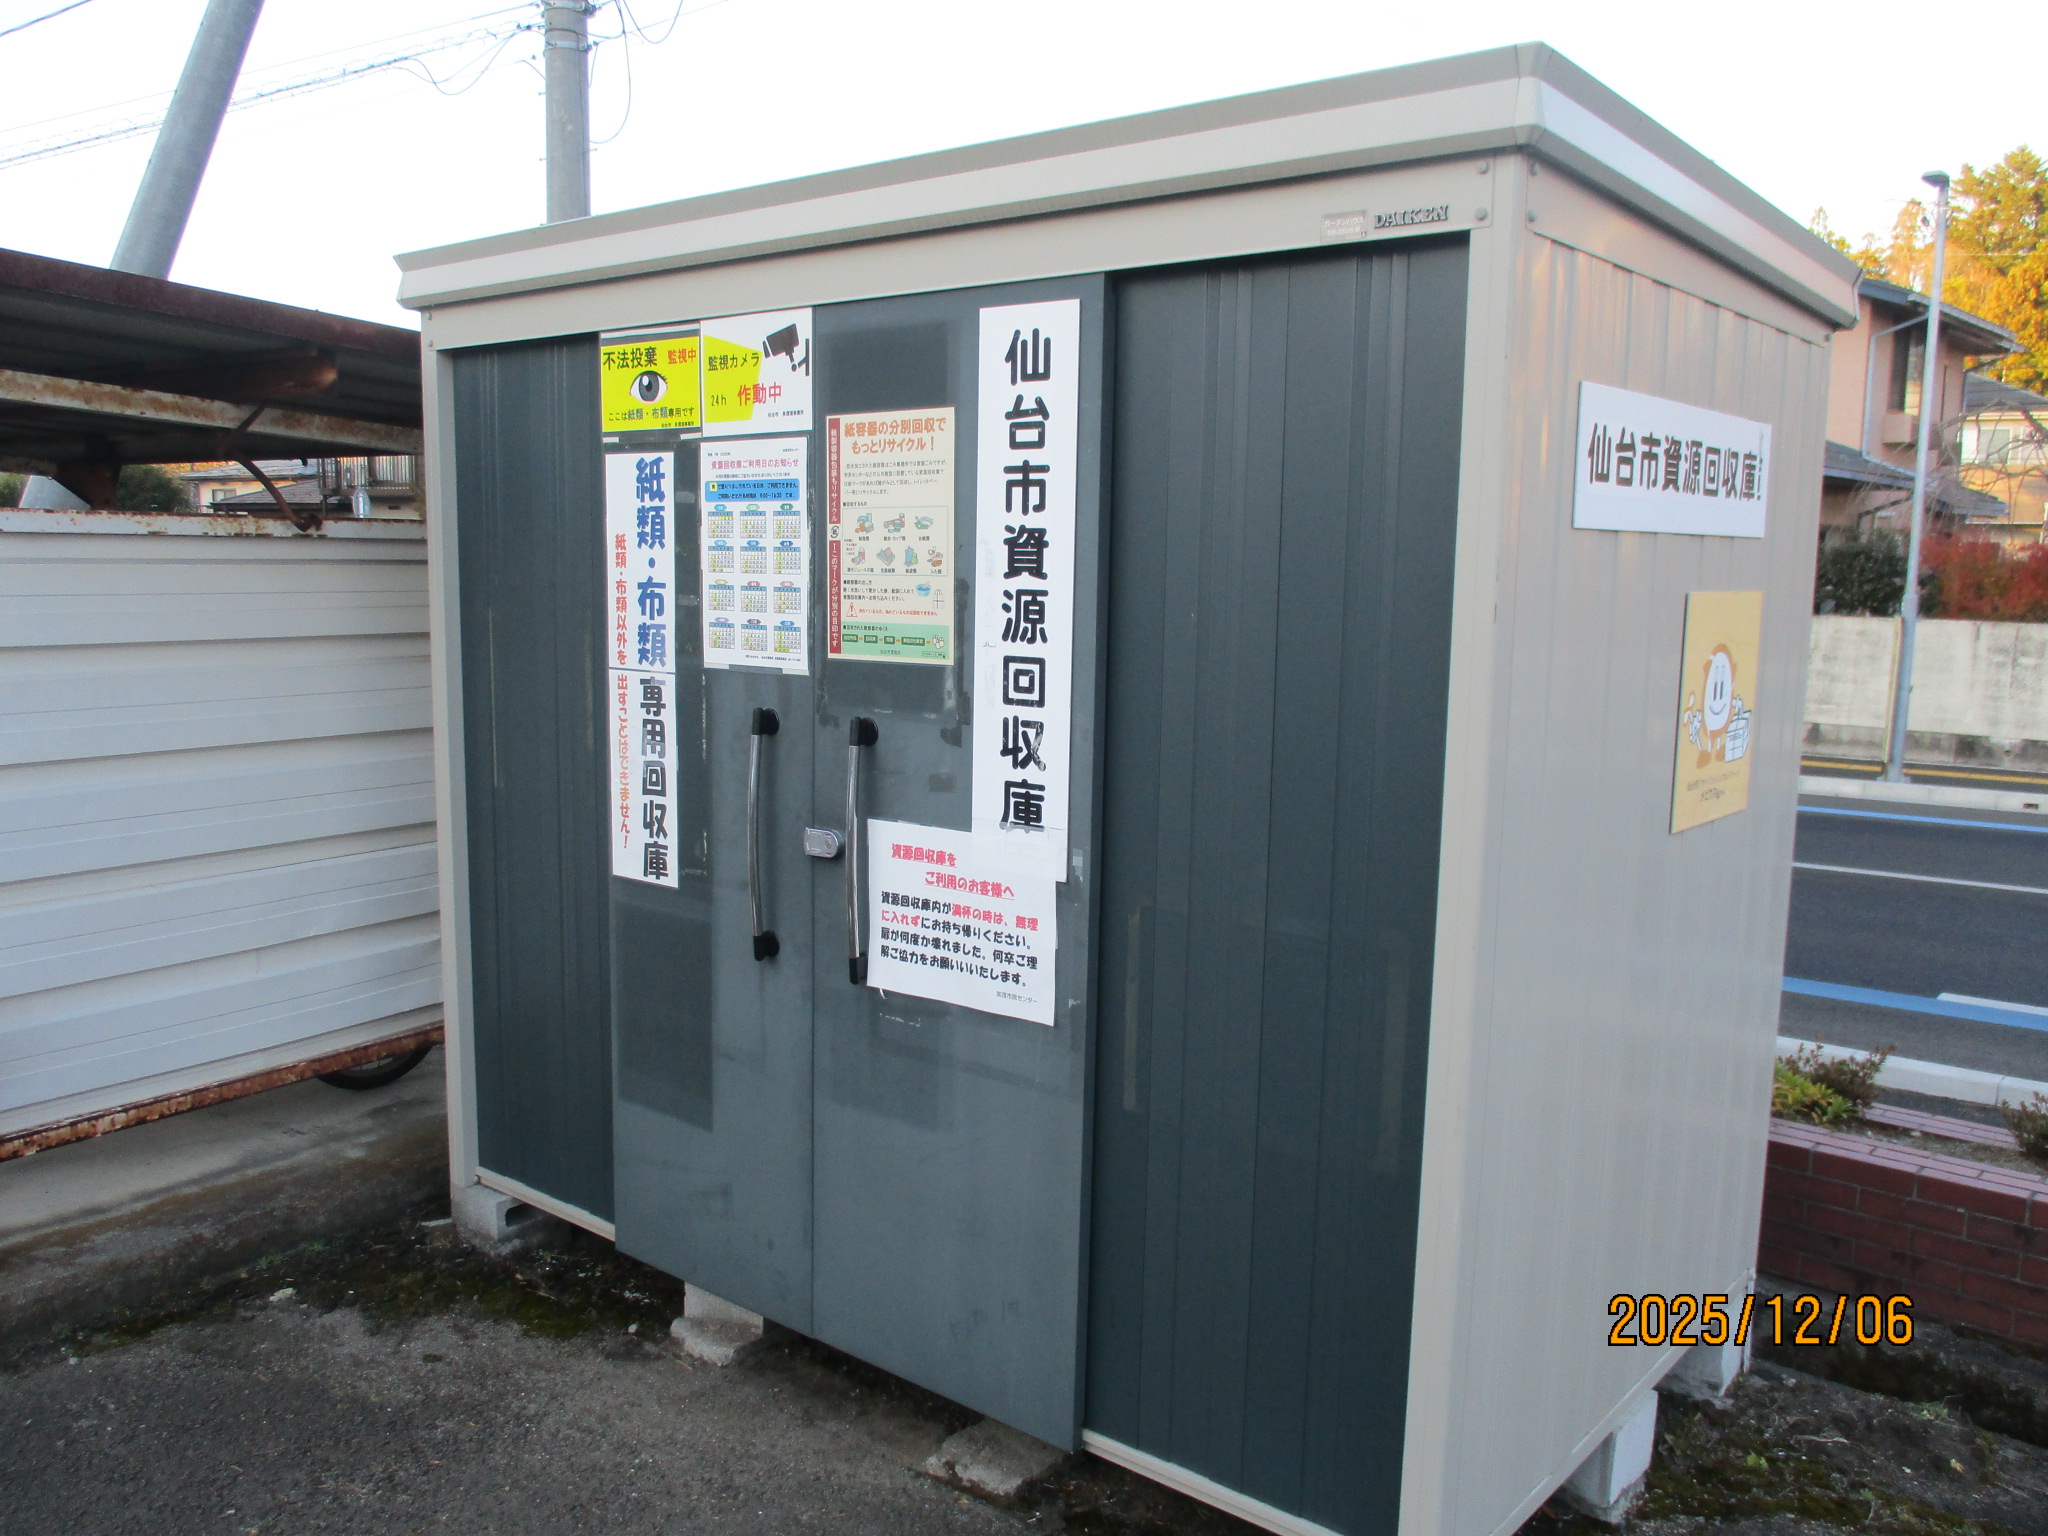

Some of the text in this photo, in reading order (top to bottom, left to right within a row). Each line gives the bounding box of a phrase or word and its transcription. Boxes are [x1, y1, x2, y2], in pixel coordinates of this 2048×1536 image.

[1374, 205, 1448, 229] DAIKEN
[602, 346, 697, 371] 不法投棄 監視中
[708, 352, 760, 371] 監視カメラ
[737, 382, 782, 406] 作動中
[608, 407, 695, 421] ここは紙類・布類専用です
[844, 417, 947, 438] 紙容器の分別回収で
[711, 458, 799, 470] 資源回収庫ご利用日のお知らせ
[1588, 423, 1758, 502] 仙台市資源回収庫
[1000, 327, 1052, 835] 仙台市資源回収庫
[892, 843, 957, 867] 資源回収庫を
[924, 871, 1015, 899] ご利用のお客様へ
[881, 890, 1039, 931] 資源回収庫内が満杯の時は、無理
[881, 909, 1031, 950] に入れずにお持ち帰りください。
[881, 926, 1038, 970] 扉が何度か壊れました。何卒ご理
[881, 944, 1027, 987] 解ご協力をお願いいいたします。
